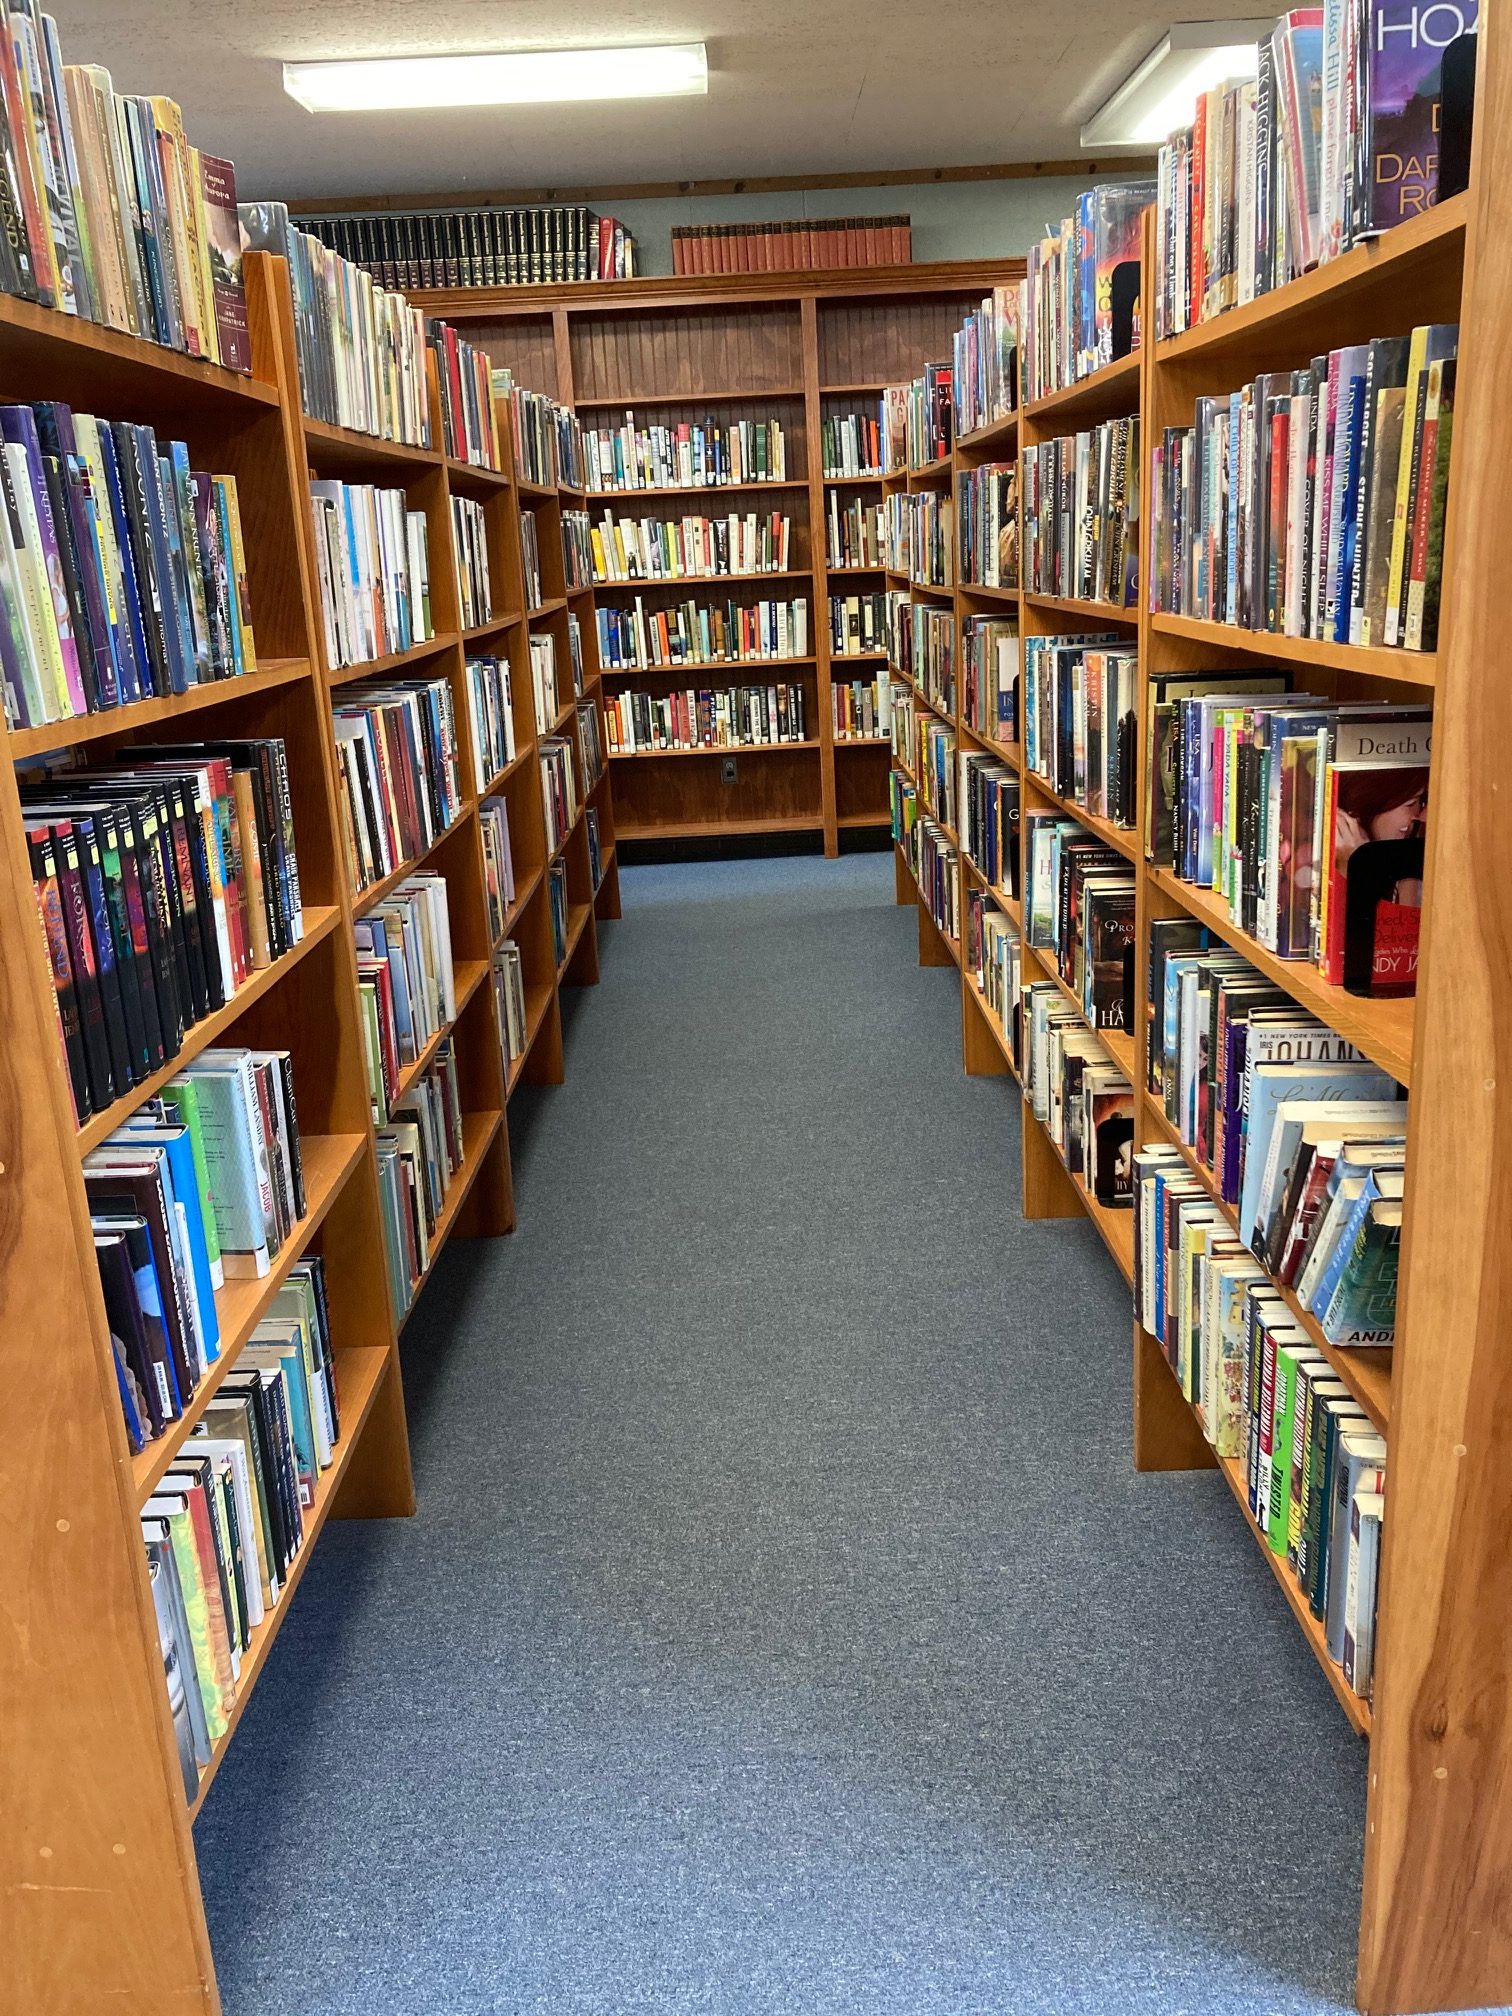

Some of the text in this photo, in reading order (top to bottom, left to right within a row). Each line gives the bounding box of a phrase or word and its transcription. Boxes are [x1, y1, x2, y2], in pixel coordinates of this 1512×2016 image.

[1257, 42, 1271, 87] JACK
[150, 440, 169, 539] DEAN KOONTZ
[1357, 738, 1417, 762] Death
[278, 753, 292, 820] CHAOS
[1101, 1010, 1124, 1026] HA
[1270, 1032, 1286, 1040] NEW
[1288, 1032, 1308, 1040] YORK
[1260, 1040, 1273, 1050] IRIS
[245, 1060, 264, 1147] WILLIAM LANDAY
[259, 1182, 273, 1213] JACOB
[1270, 1463, 1284, 1520] TWISTED
[1287, 1496, 1302, 1552] GONE
